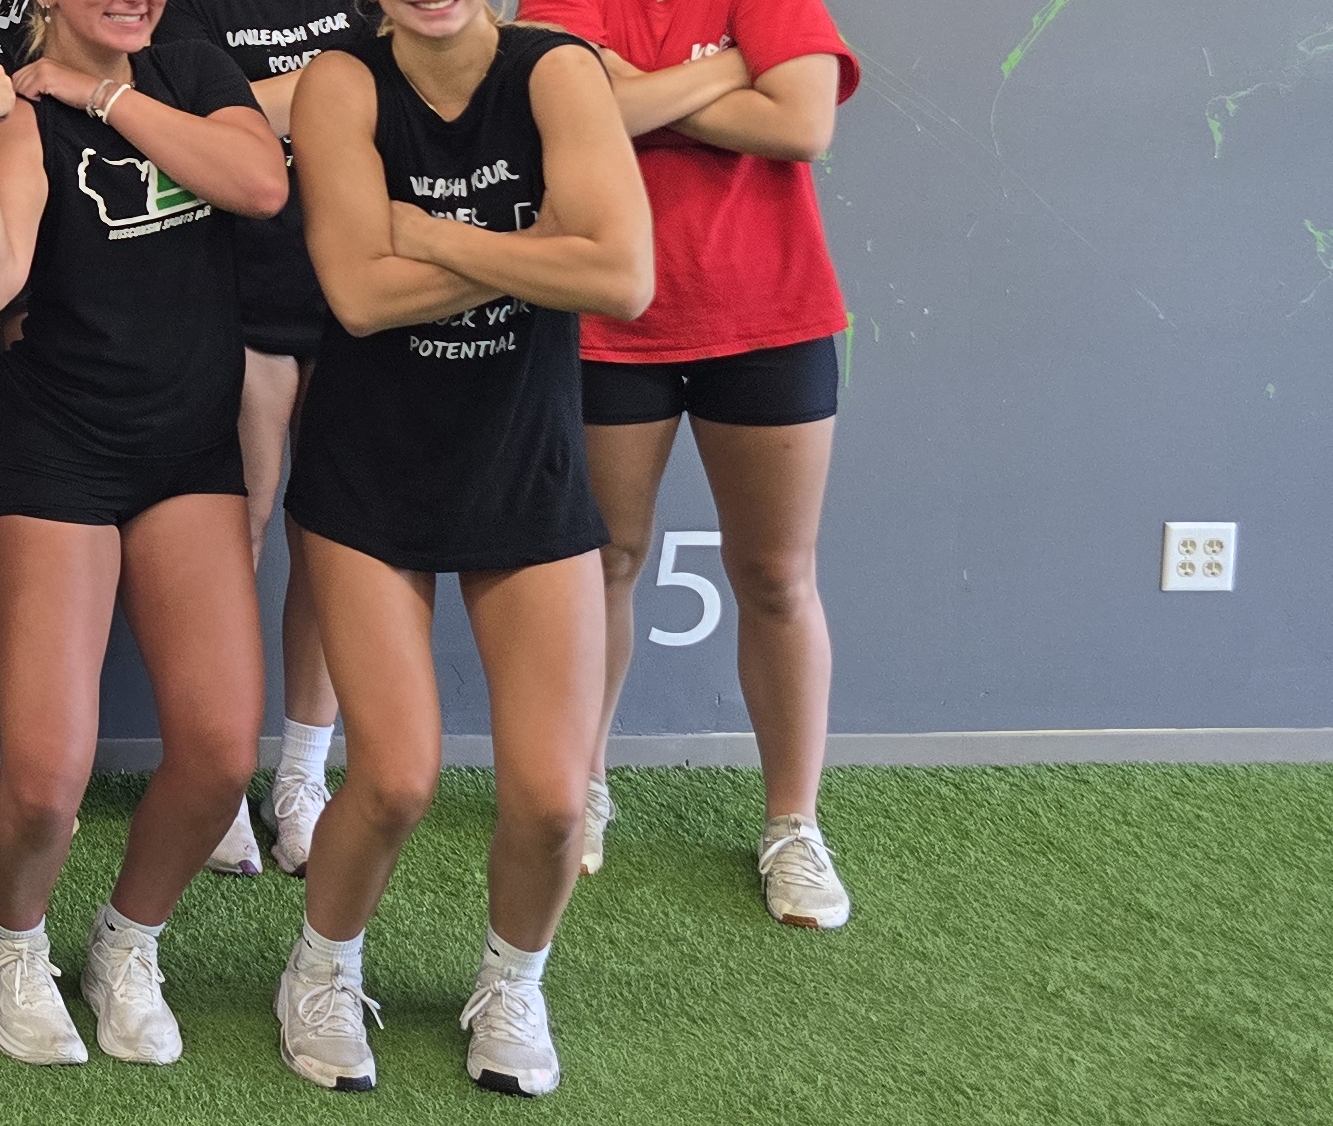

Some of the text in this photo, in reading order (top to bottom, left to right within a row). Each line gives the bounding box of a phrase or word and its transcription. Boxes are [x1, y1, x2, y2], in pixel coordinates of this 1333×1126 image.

[226, 12, 351, 48] UNLEASH YOUR
[268, 48, 322, 74] POWE
[409, 330, 517, 360] POTENTIAL
[648, 530, 722, 646] 5
